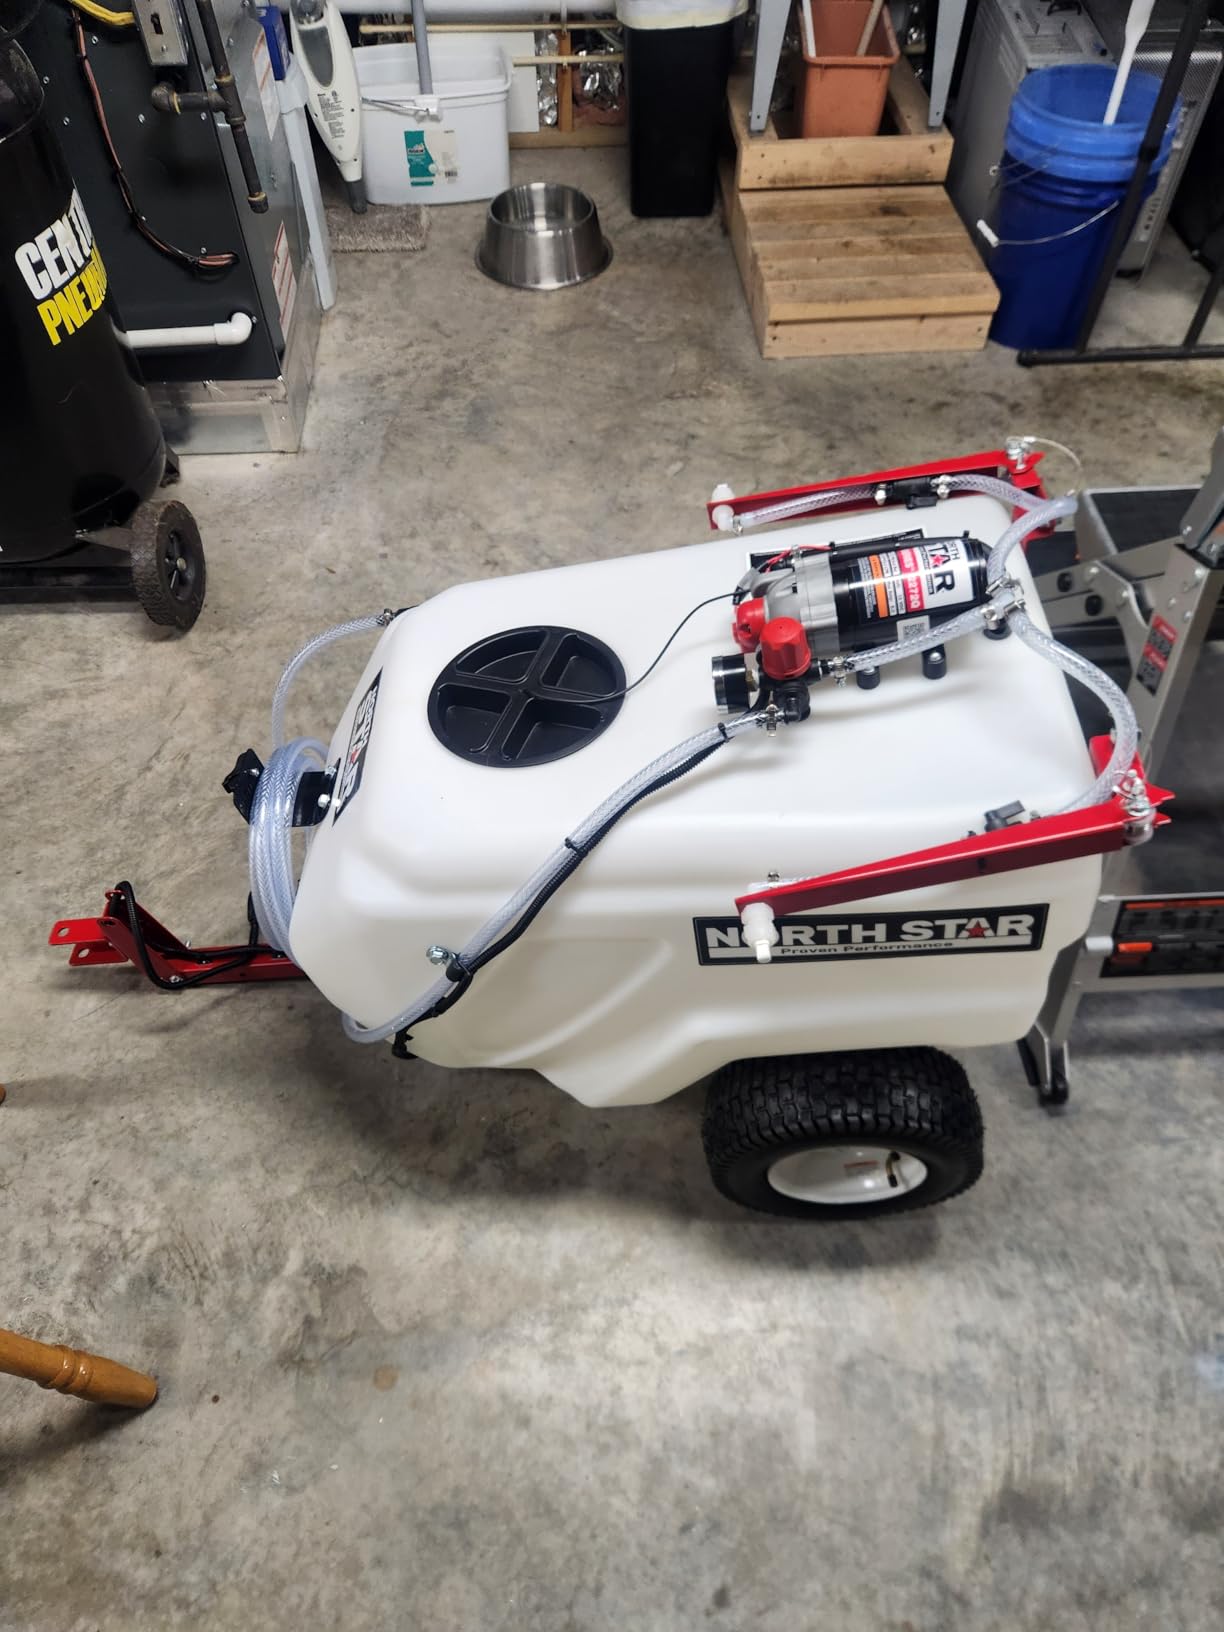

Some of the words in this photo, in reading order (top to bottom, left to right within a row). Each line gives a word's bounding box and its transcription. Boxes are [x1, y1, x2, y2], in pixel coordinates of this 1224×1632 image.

[929, 544, 955, 594] TAR
[705, 923, 887, 947] NRTH
[900, 914, 1034, 941] STAR
[781, 947, 837, 955] Proven
[843, 942, 953, 952] Performance
